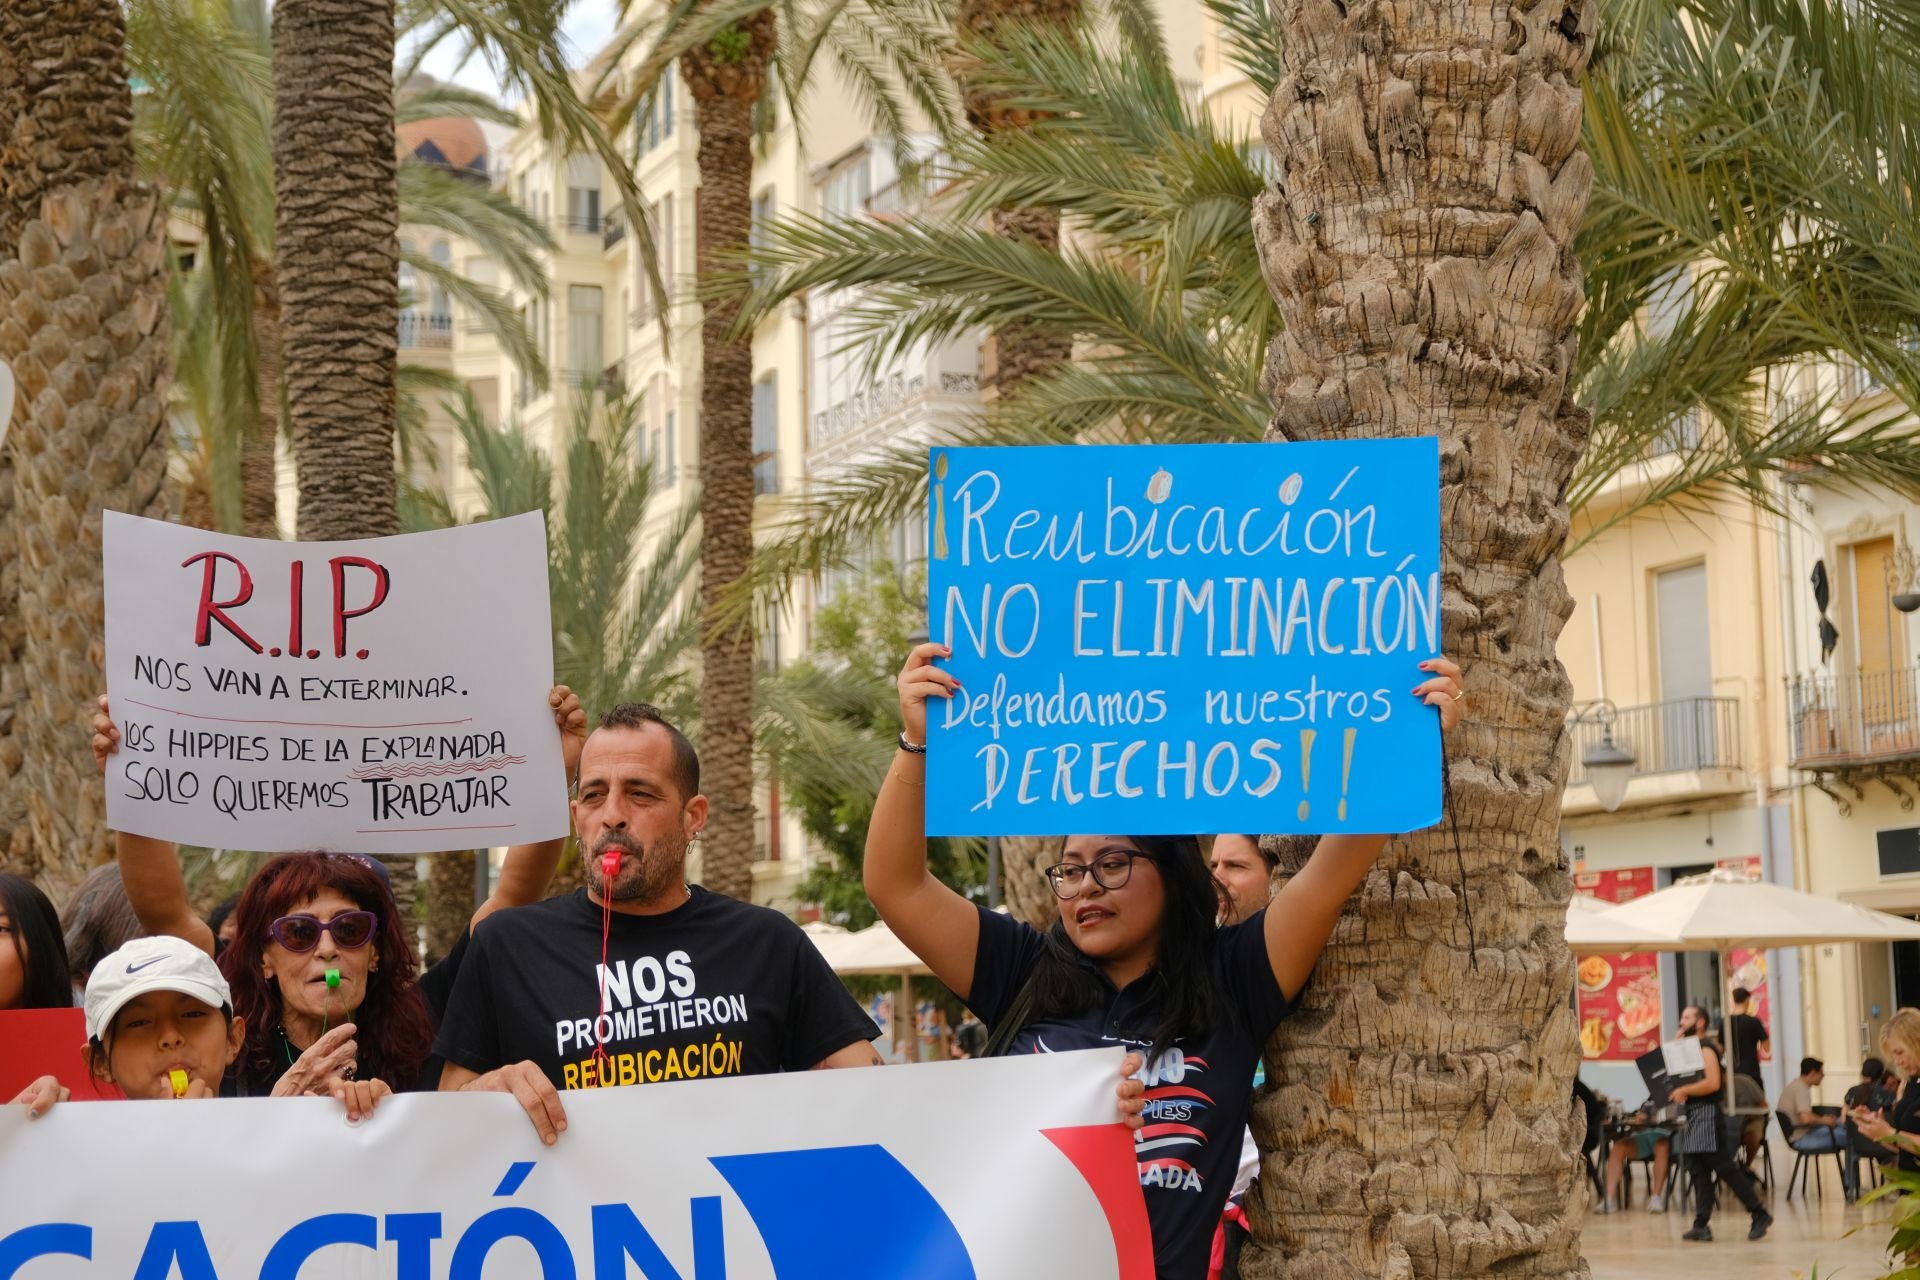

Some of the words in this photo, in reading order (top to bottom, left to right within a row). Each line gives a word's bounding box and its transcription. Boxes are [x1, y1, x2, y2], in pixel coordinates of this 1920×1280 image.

[181, 551, 391, 660] R.I.P.
[942, 583, 1040, 662] NO
[1073, 553, 1439, 657] ELIMINACIÓN
[134, 654, 192, 692] NOS
[203, 665, 262, 697] VAN
[269, 674, 290, 700] A
[300, 675, 469, 702] EXTERMINAR.
[941, 672, 1167, 739] Defendamos
[1204, 675, 1392, 725] nuestros
[124, 720, 156, 753] LOS
[168, 728, 269, 762] HIPPIES
[281, 737, 317, 762] DE
[324, 738, 349, 762] LA
[361, 730, 505, 763] EXPLANADA
[124, 760, 200, 805] SOLO
[212, 774, 350, 822] QUEREMOS
[360, 775, 511, 822] TRABAJAR
[596, 950, 697, 1013] NOS
[556, 993, 749, 1057] PROMETIERON
[563, 1033, 743, 1090] REUBICACIÓN
[1138, 1098, 1193, 1121] PIES
[1137, 1162, 1203, 1193] ADA
